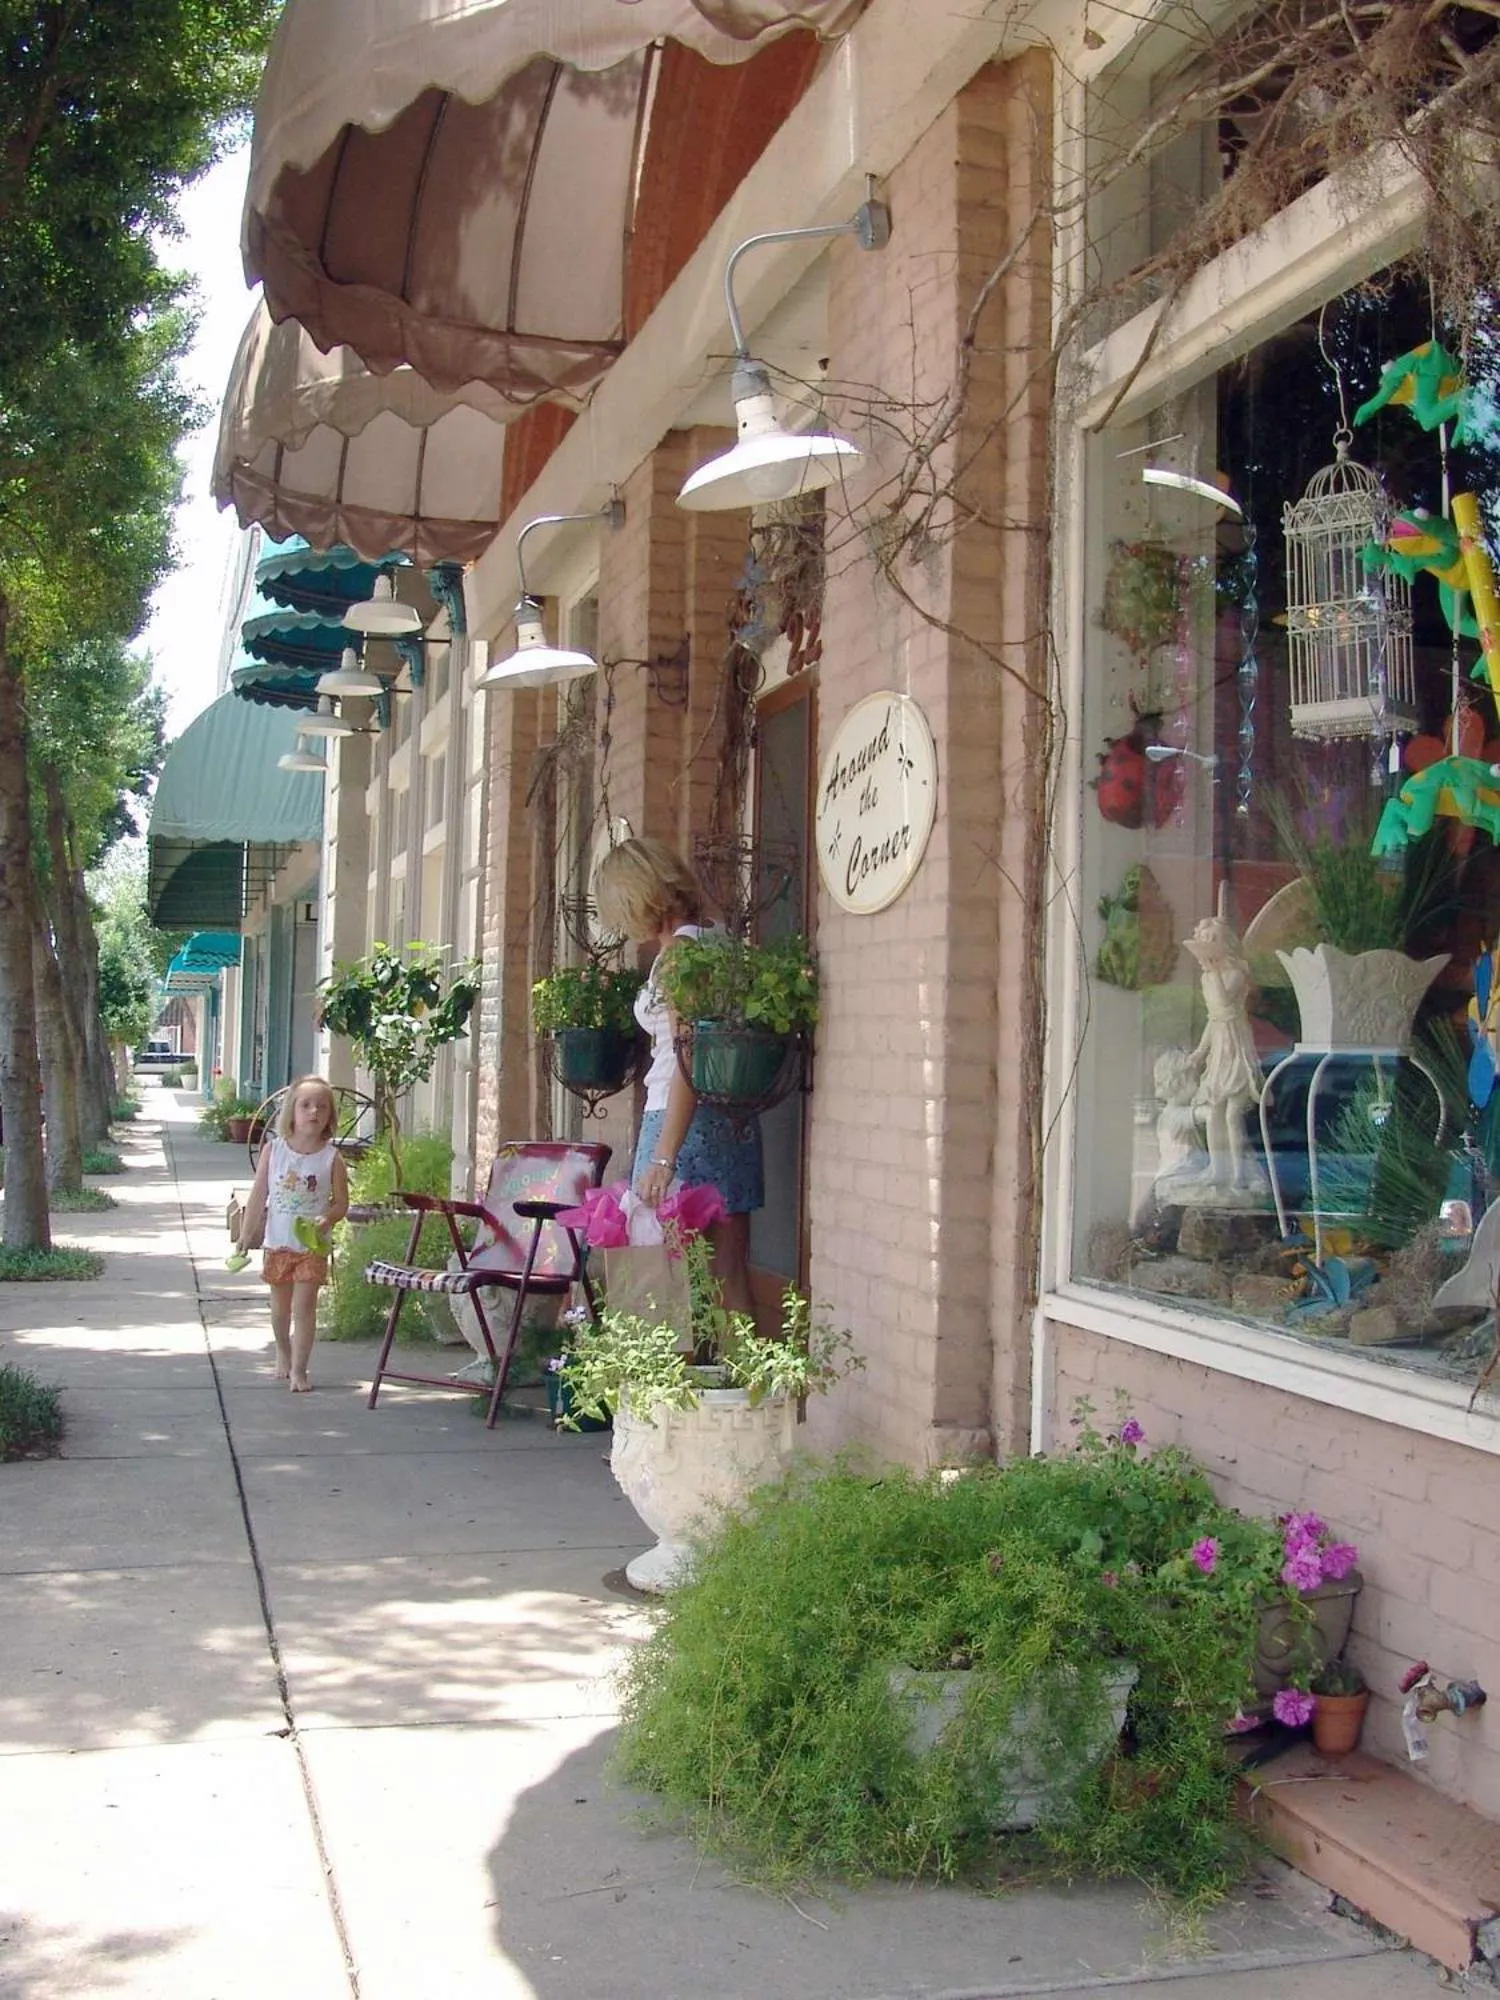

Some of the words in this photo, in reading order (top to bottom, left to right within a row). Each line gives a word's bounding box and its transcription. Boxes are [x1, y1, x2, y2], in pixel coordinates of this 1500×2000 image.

[824, 705, 891, 813] Around
[859, 775, 878, 816] the
[846, 824, 910, 896] Corner
